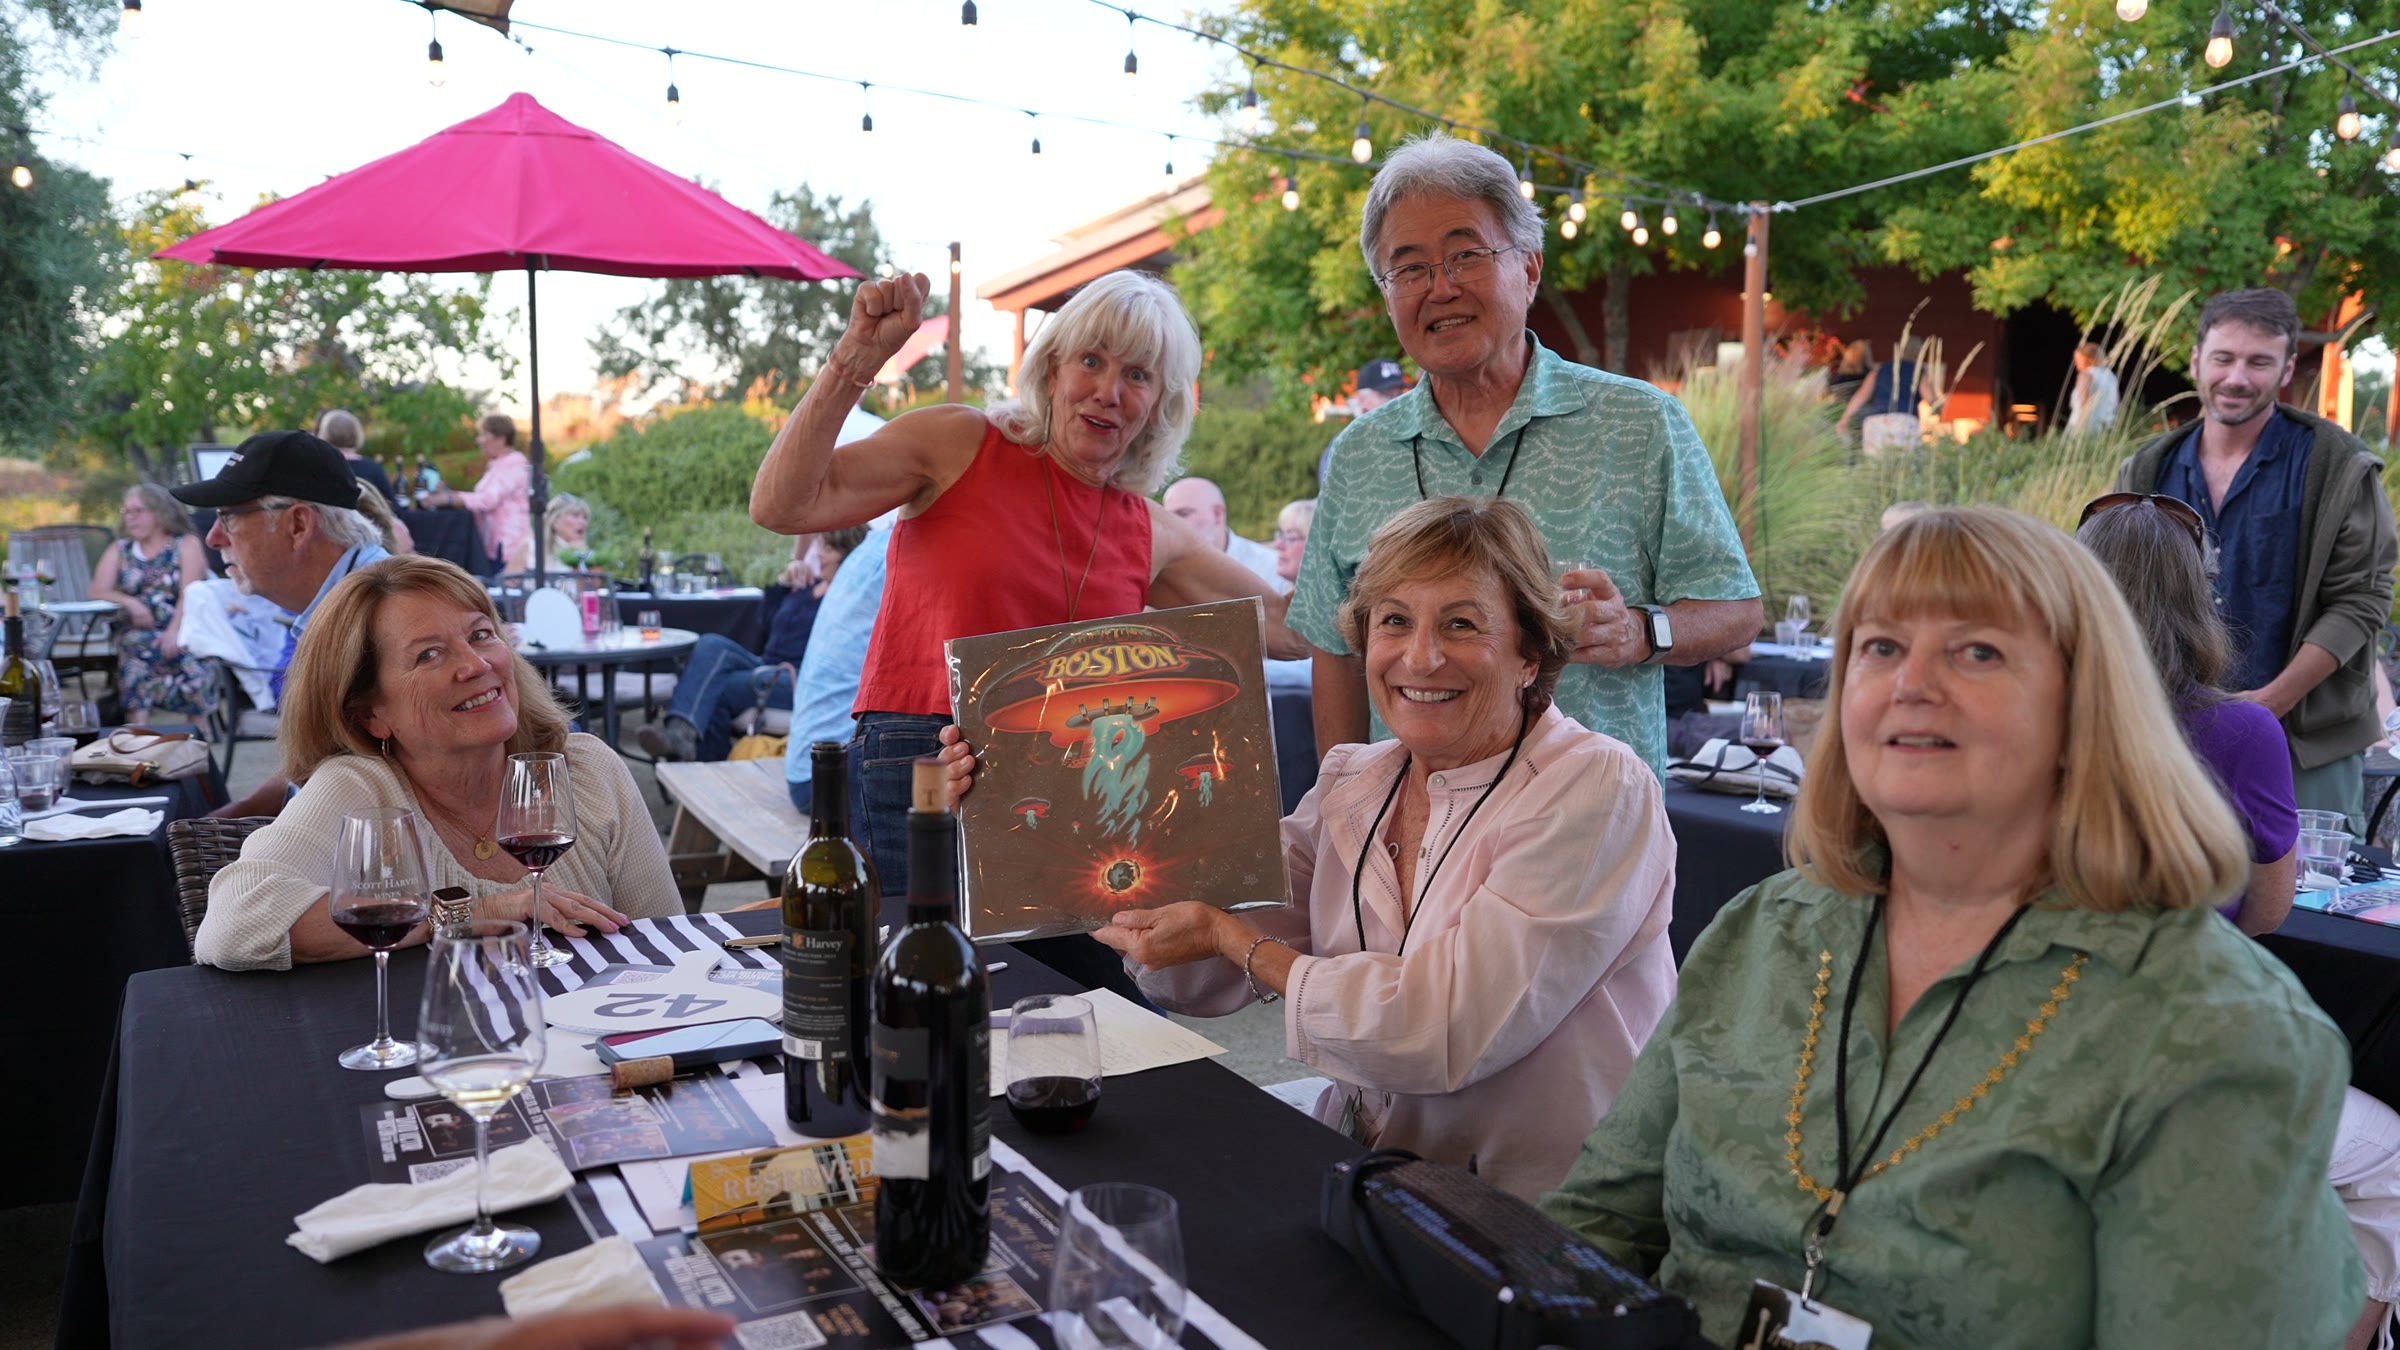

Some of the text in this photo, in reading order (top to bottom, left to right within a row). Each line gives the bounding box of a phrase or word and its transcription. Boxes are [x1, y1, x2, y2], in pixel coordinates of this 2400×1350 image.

[1046, 645, 1178, 679] BOSTON
[351, 880, 382, 890] SCOTT
[374, 891, 401, 899] WINES
[806, 937, 843, 951] Harvey
[594, 993, 728, 1018] 42
[723, 1157, 873, 1202] RESERVED
